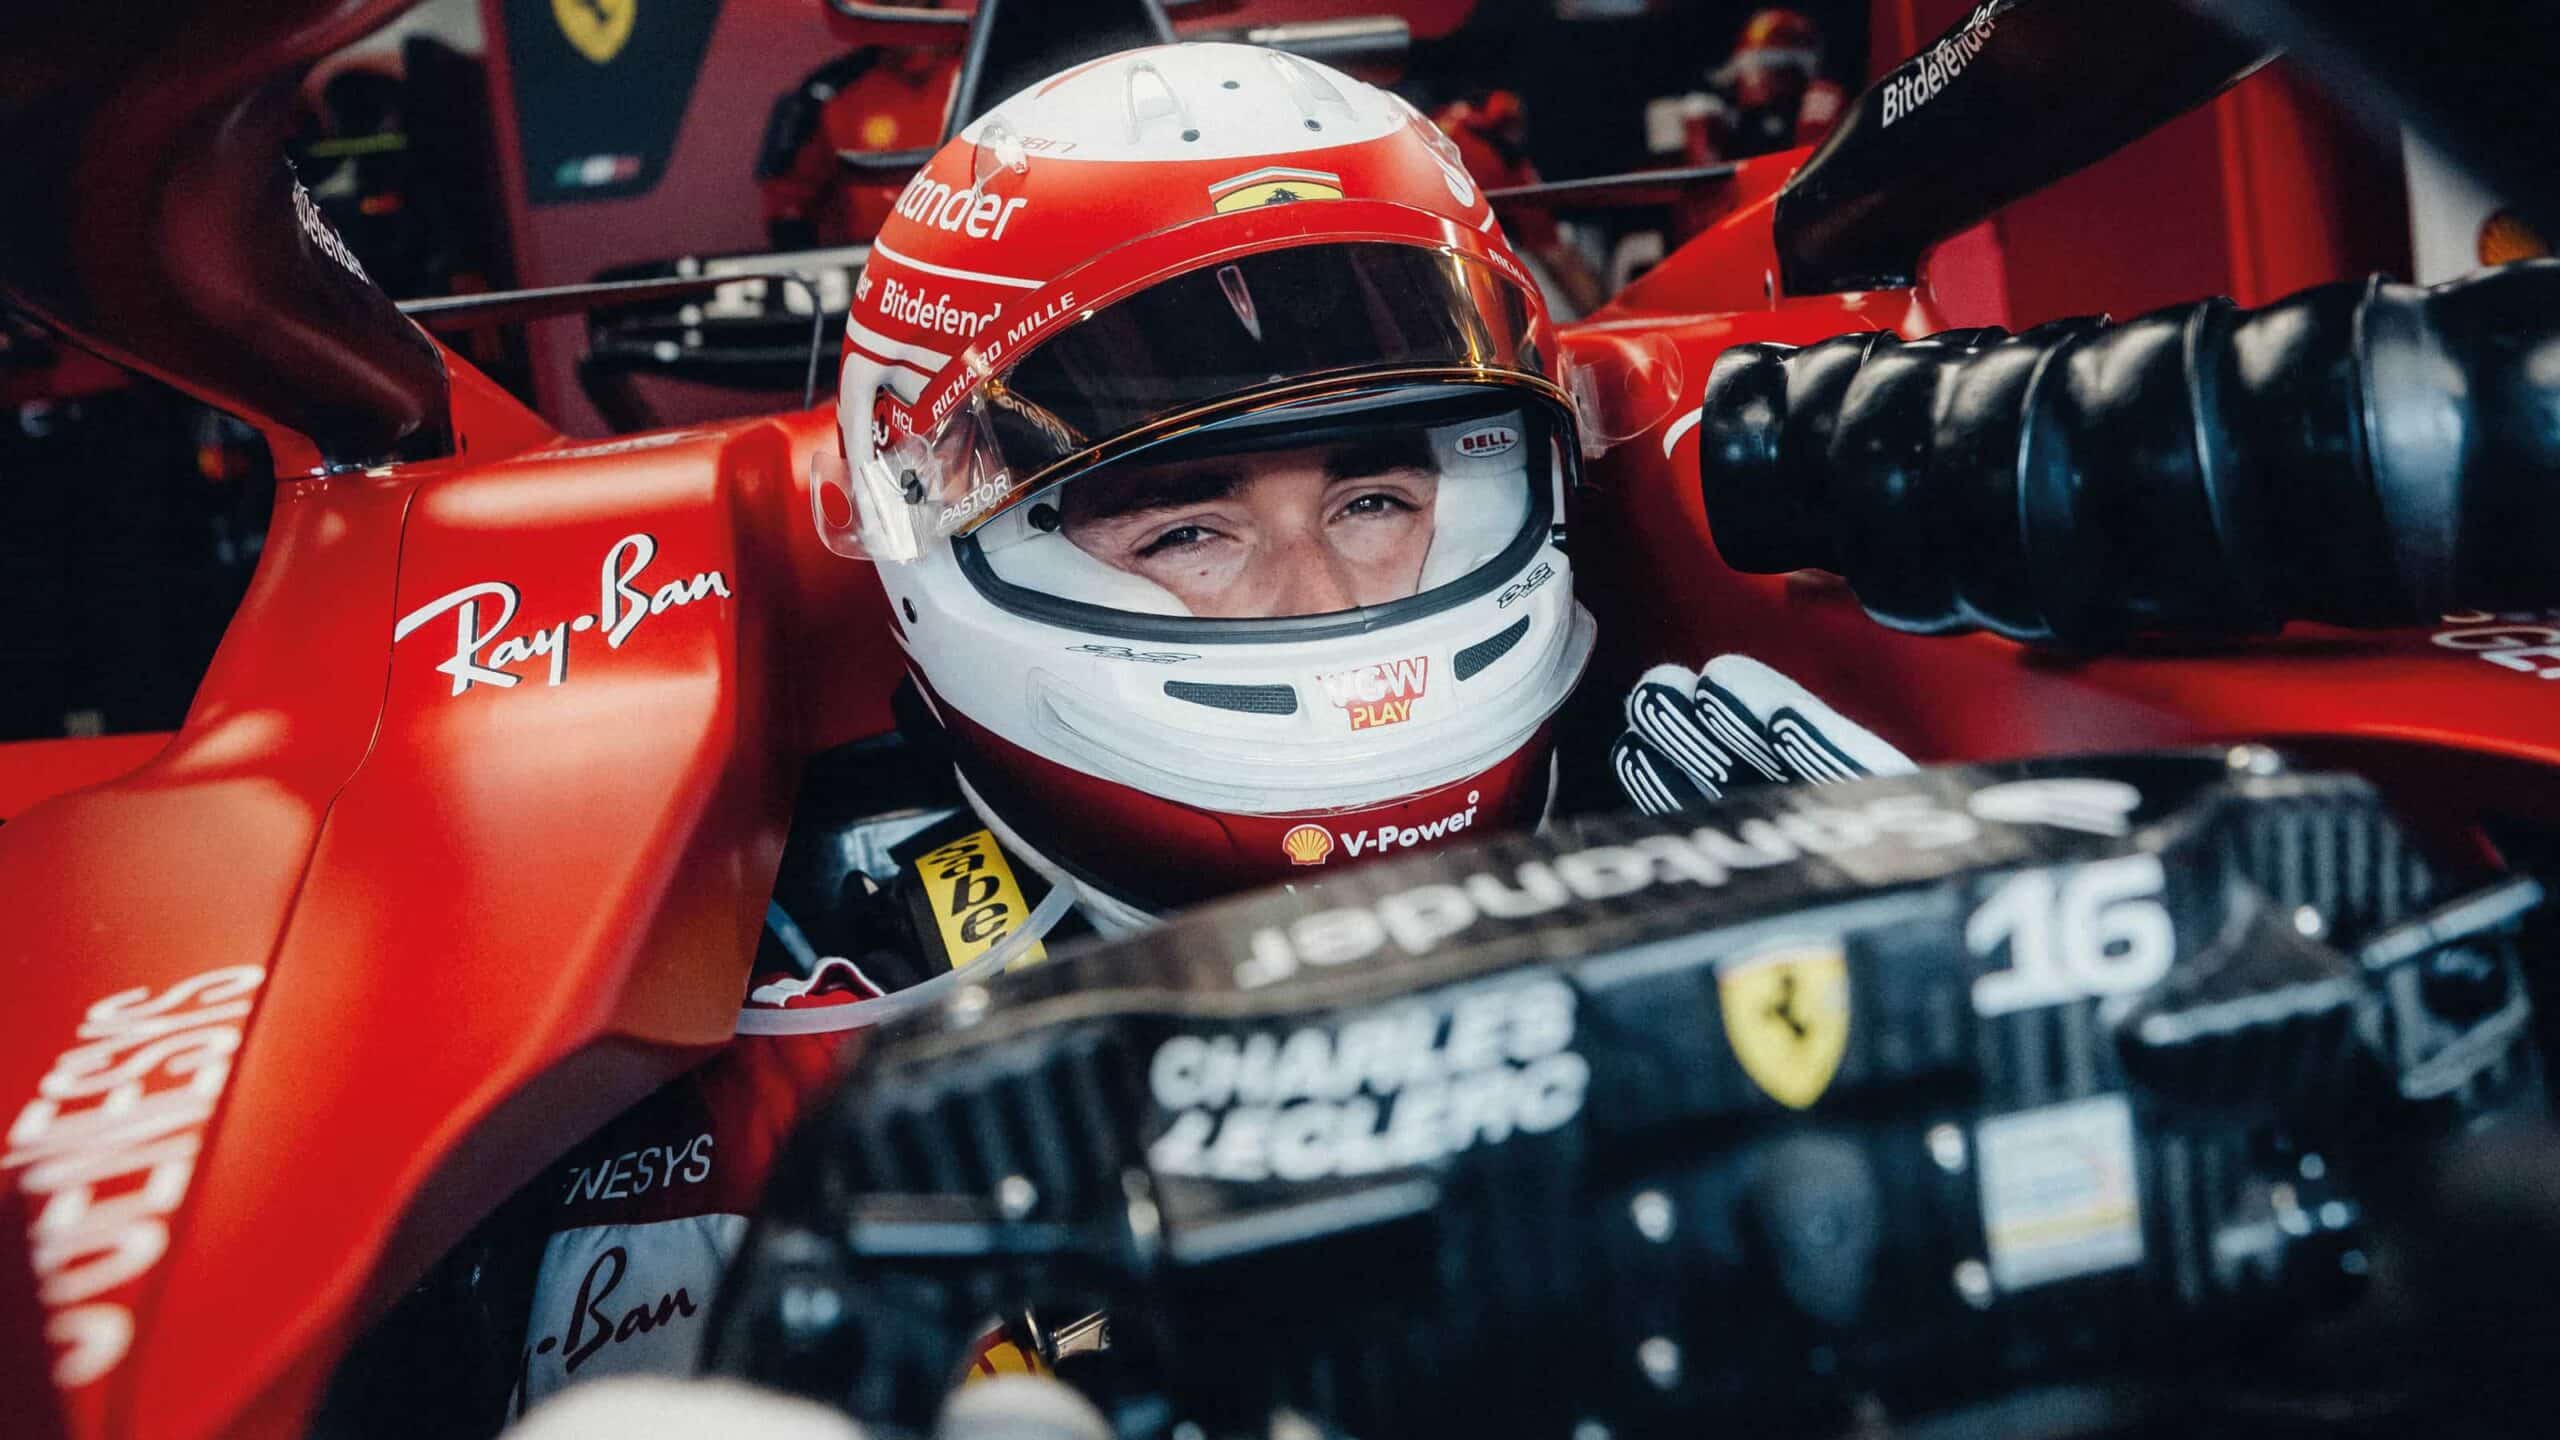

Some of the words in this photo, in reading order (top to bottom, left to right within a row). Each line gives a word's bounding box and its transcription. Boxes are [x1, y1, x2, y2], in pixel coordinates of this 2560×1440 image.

[1007, 290, 1077, 347] MILLE
[891, 403, 913, 434] HCL
[1462, 431, 1512, 451] BELL
[936, 473, 1008, 530] PASTOR
[1352, 699, 1412, 730] PLAY
[1965, 853, 2176, 1018] 16
[1150, 976, 1577, 1112] CHARLES
[1148, 1050, 1592, 1182] LECLERC
[561, 1133, 713, 1206] NESYS
